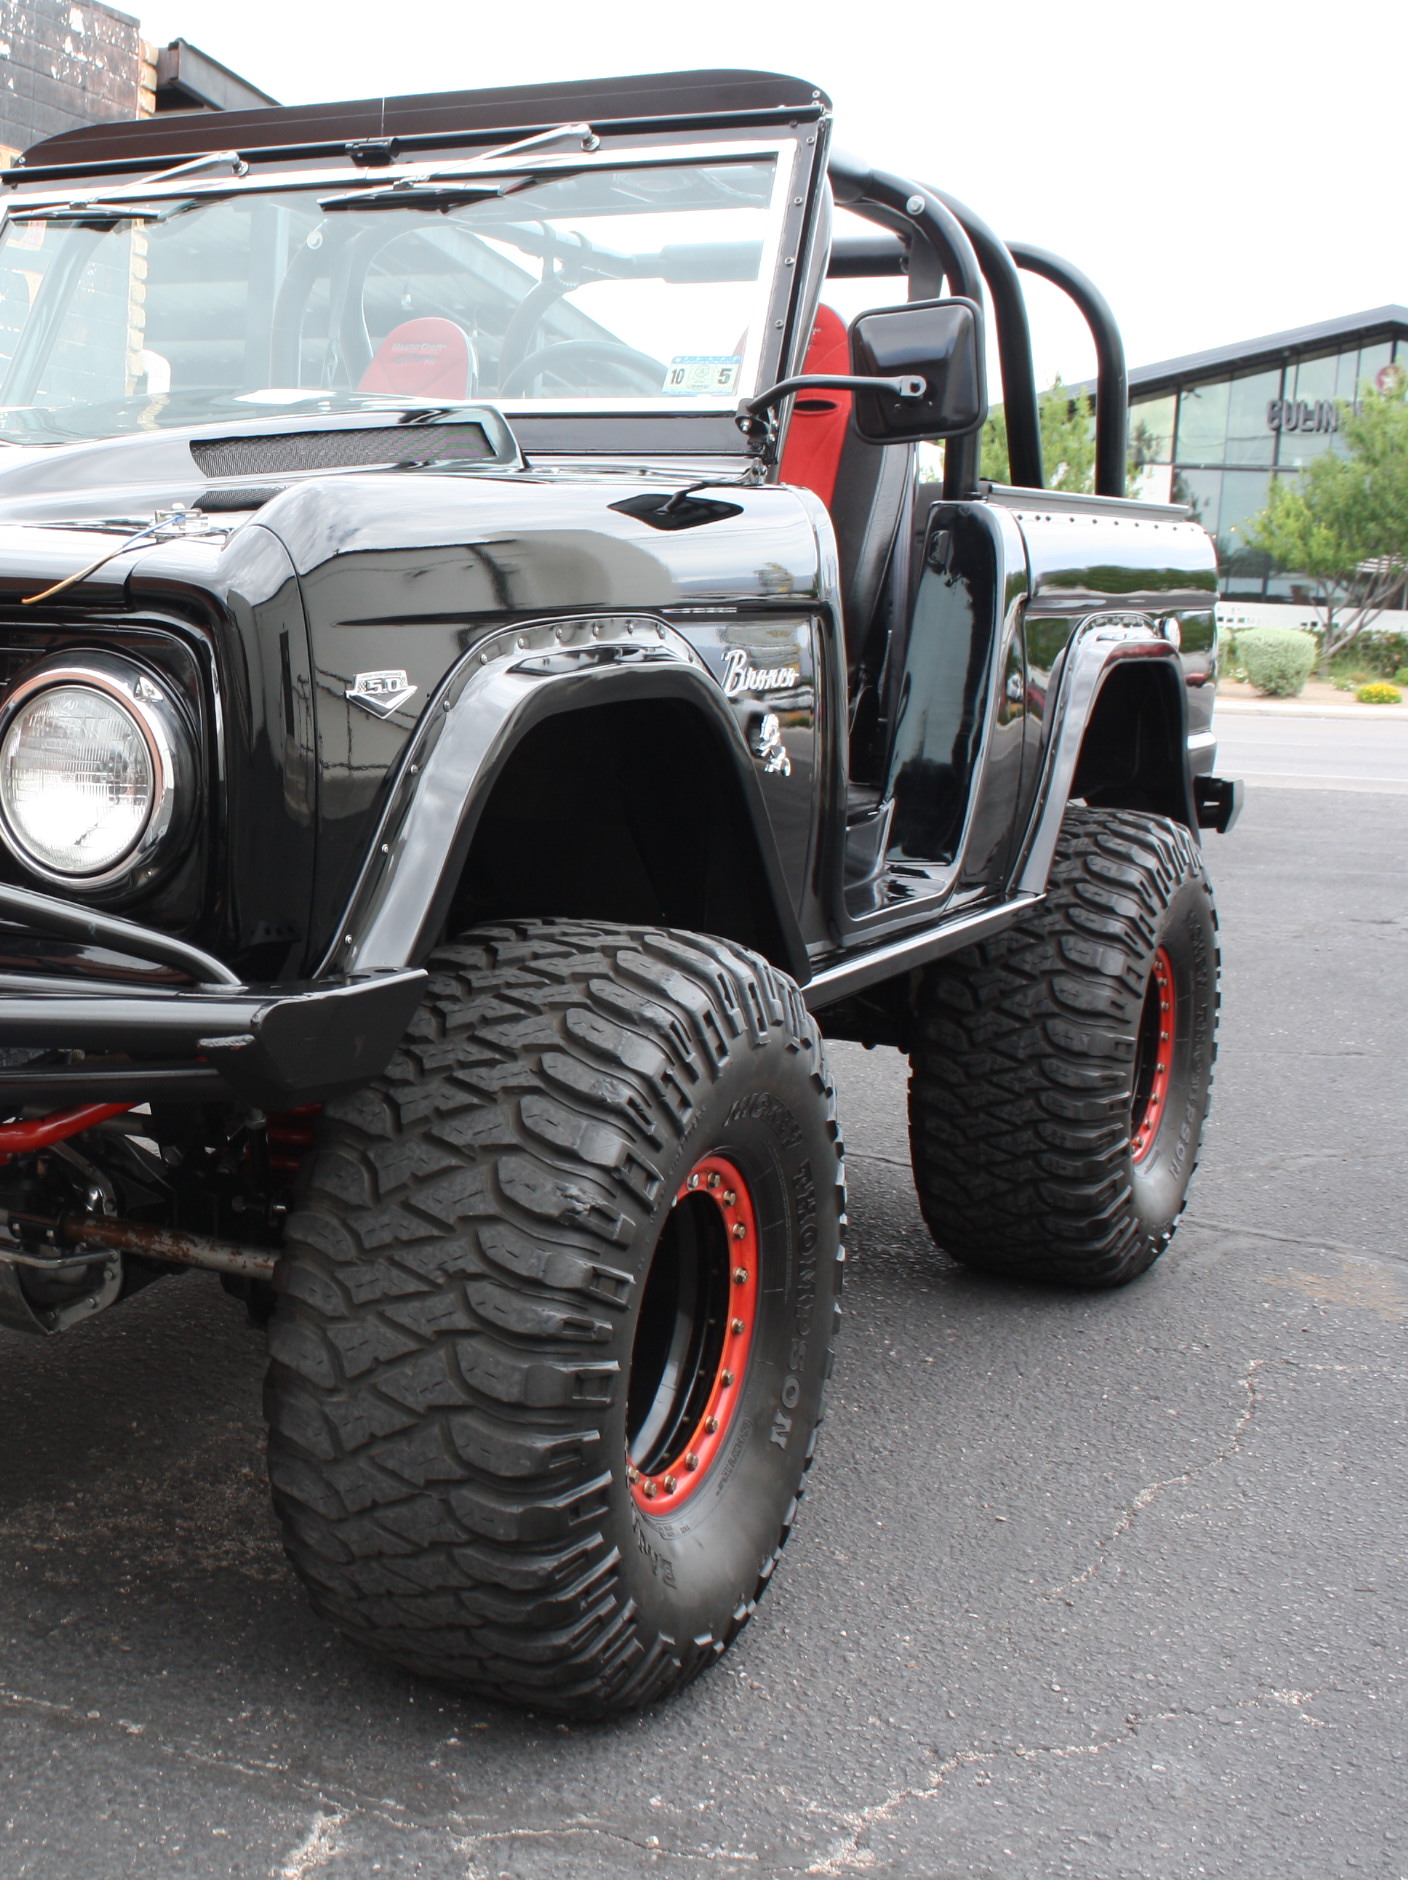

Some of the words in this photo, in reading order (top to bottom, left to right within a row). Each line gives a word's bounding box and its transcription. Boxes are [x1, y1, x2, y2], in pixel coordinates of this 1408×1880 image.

[671, 369, 685, 384] 10
[718, 369, 733, 384] 5
[366, 677, 402, 694] 5.0
[720, 648, 800, 697] Bronco
[768, 1156, 818, 1451] THOMPSON
